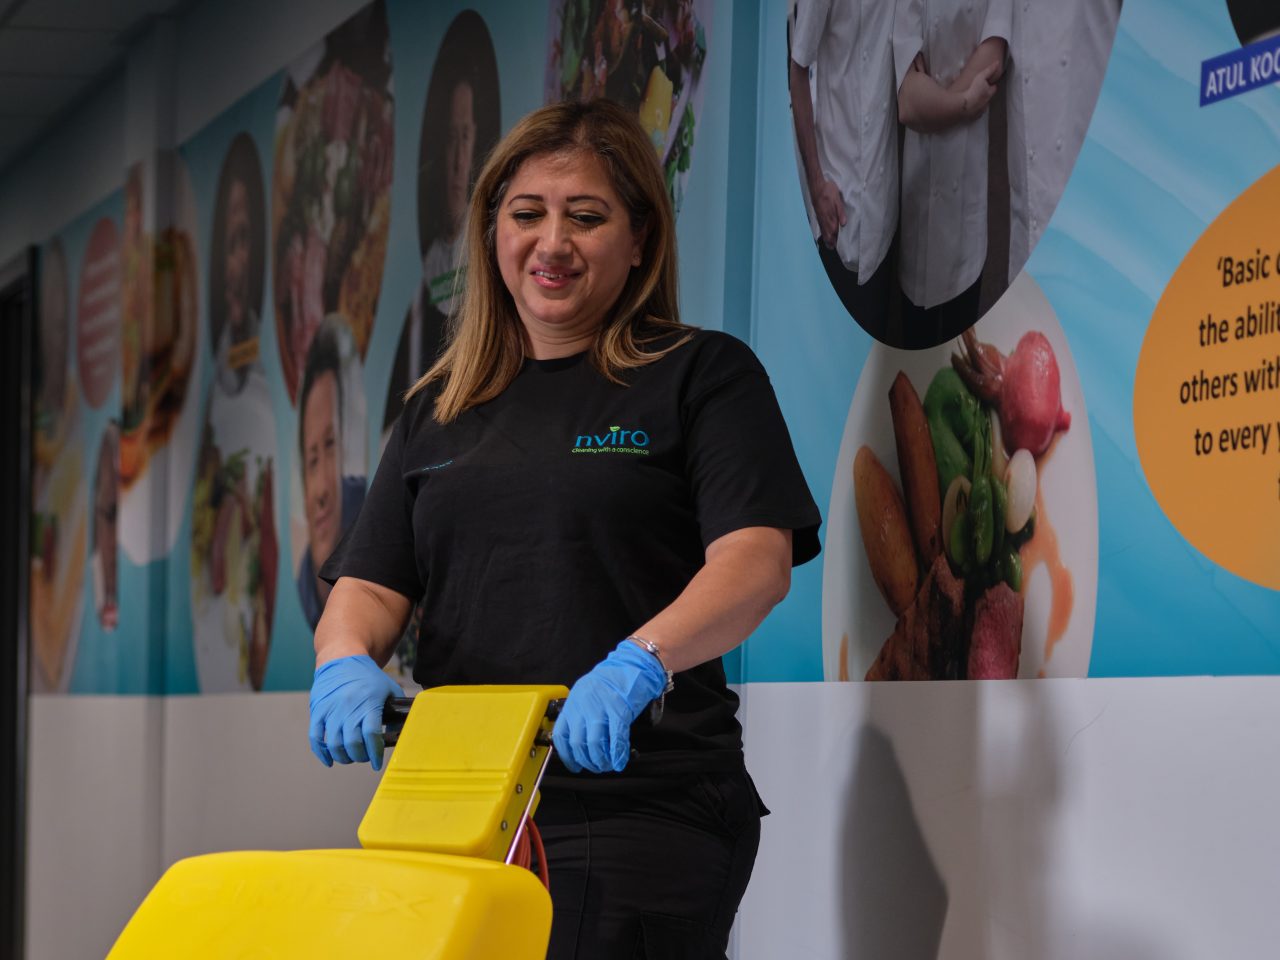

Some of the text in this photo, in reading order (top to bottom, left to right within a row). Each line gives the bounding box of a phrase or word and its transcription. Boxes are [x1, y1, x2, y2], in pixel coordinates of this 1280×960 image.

[1206, 61, 1246, 98] ATUL
[1199, 313, 1229, 347] the
[1180, 369, 1238, 404] others
[575, 426, 650, 447] nviro
[1195, 428, 1213, 456] to
[1219, 423, 1272, 455] every
